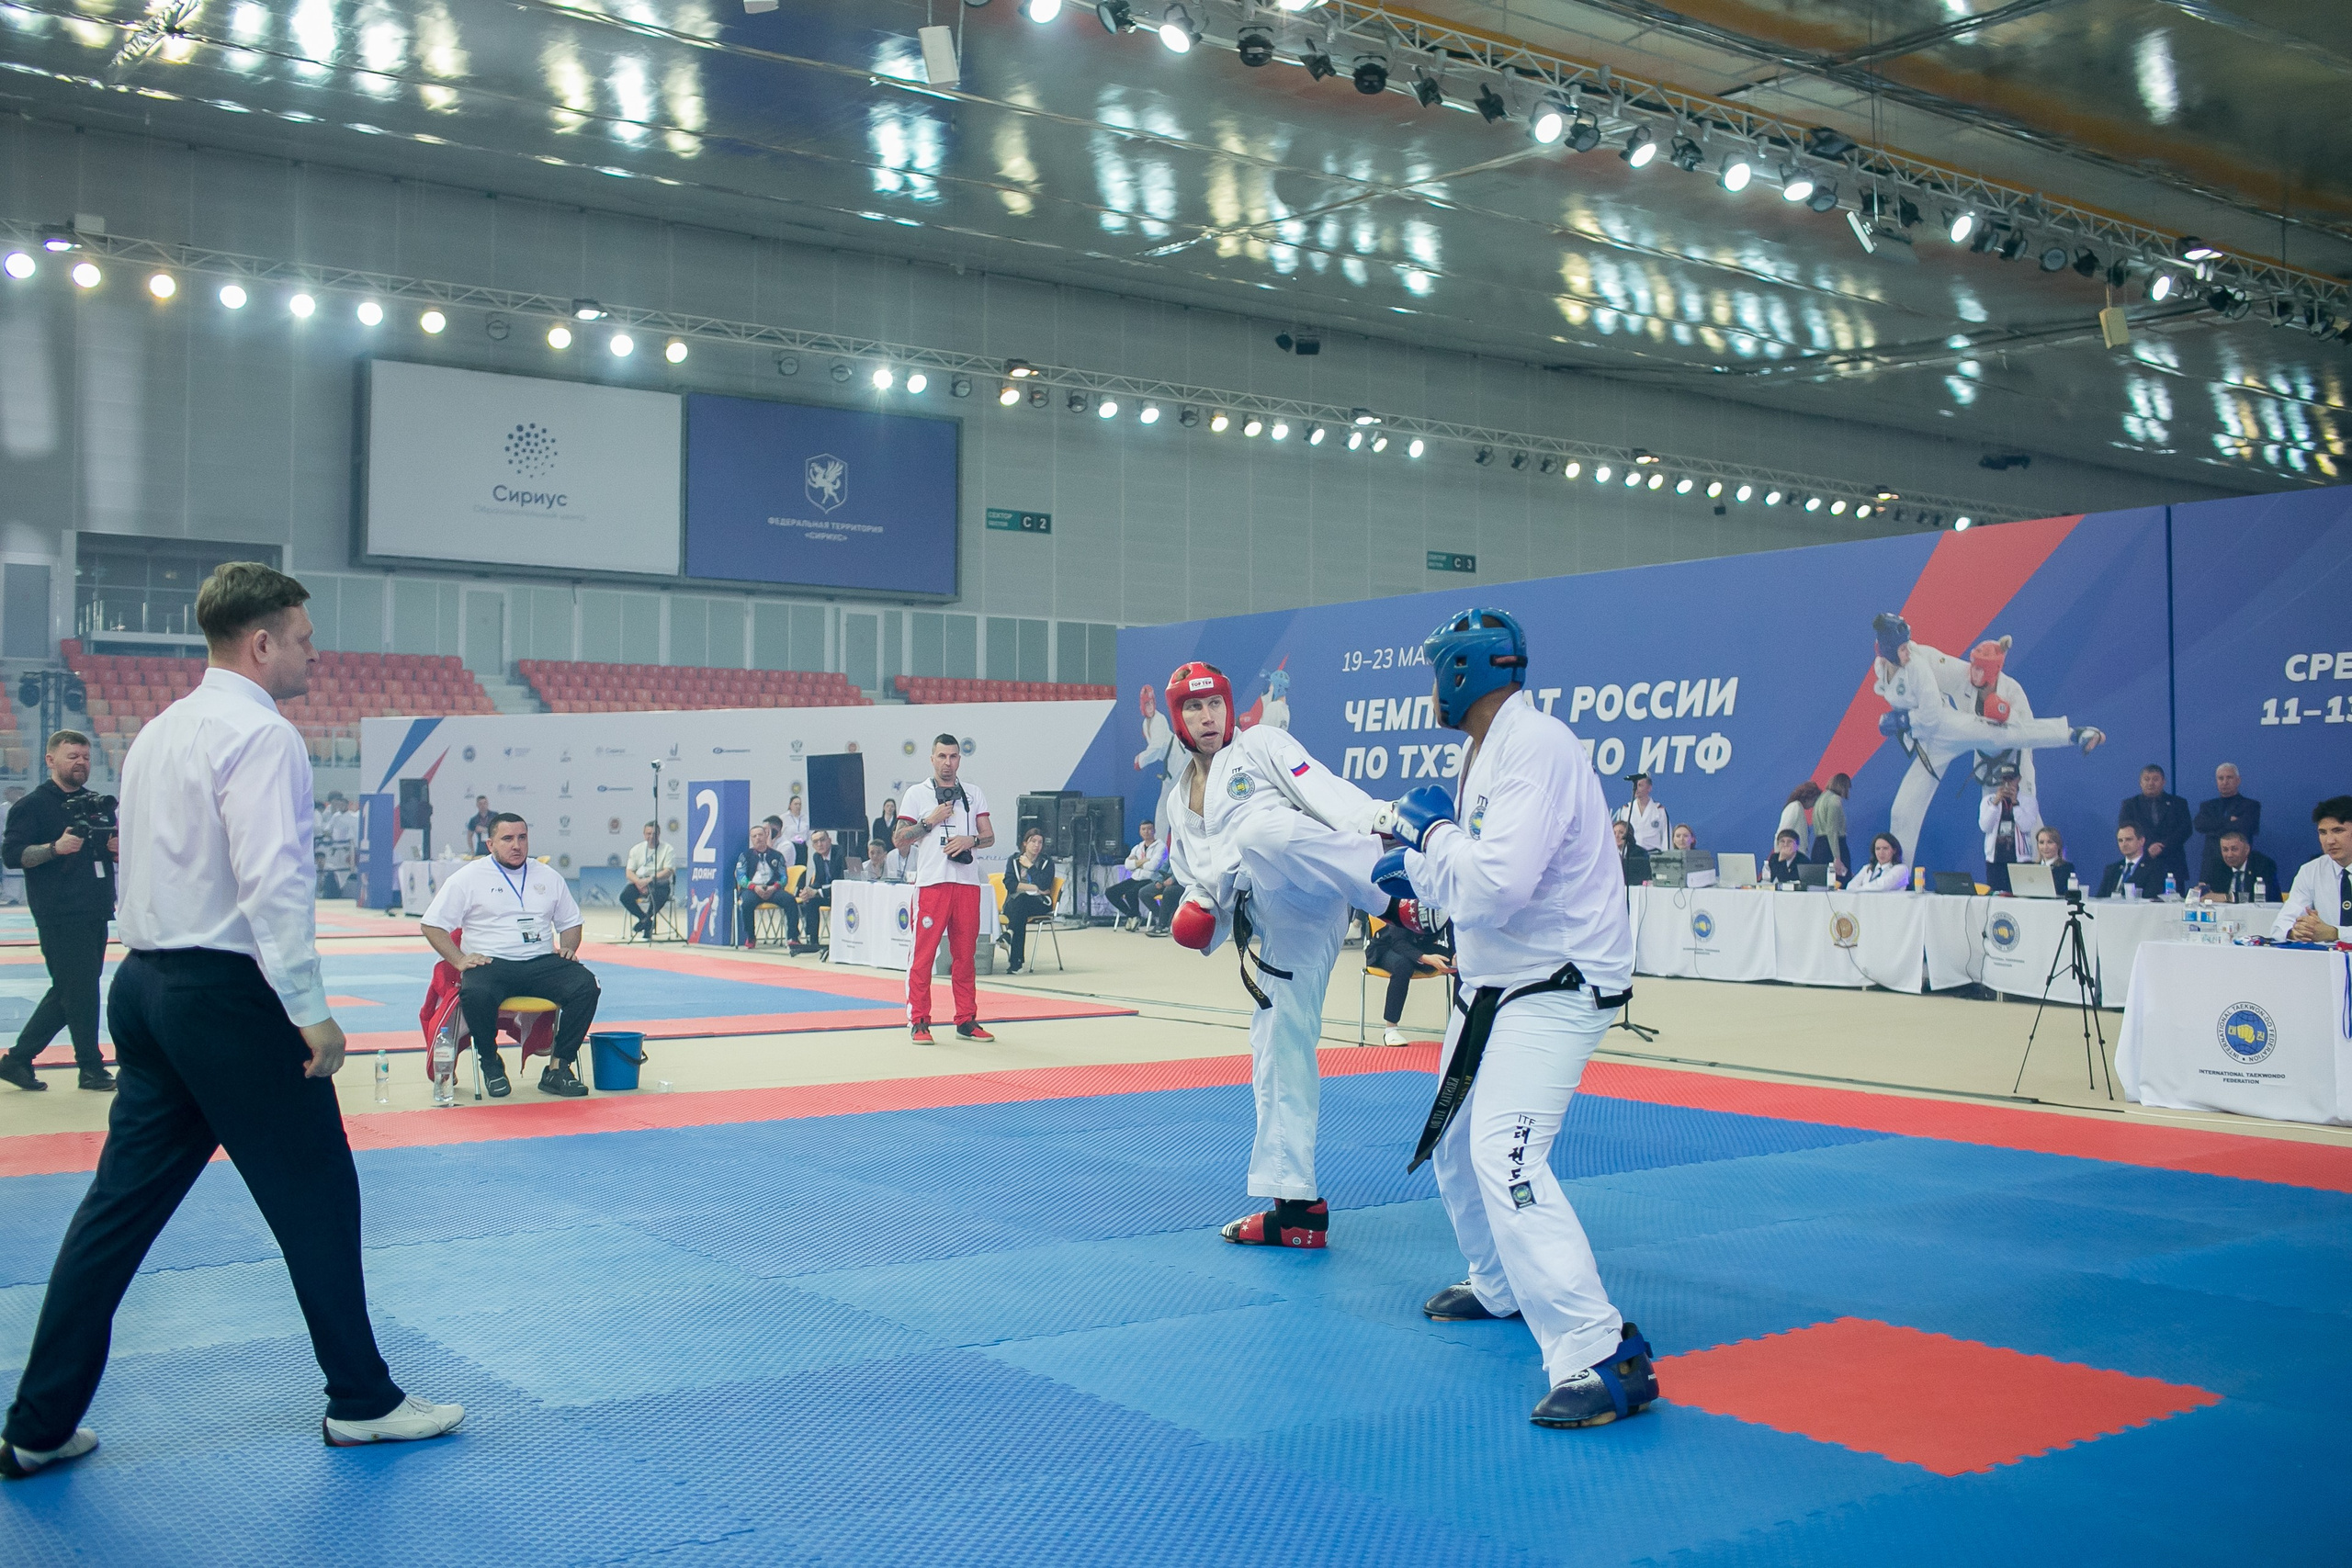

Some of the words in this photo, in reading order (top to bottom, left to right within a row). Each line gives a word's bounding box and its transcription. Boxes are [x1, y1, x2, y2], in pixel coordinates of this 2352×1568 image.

[492, 484, 568, 510] Сириус
[1039, 517, 1047, 530] 2
[1397, 646, 1433, 667] МА
[1569, 677, 1738, 723] РОССИИ
[1341, 745, 1388, 780] ПО
[1637, 732, 1733, 775] ИТФ
[692, 788, 718, 863] 2
[691, 867, 717, 882] ДОЯНГ
[2218, 1010, 2240, 1060] INTERNATIONAL
[2248, 1029, 2276, 1062] FEDERATION
[2199, 1068, 2245, 1077] INTERNATIONAL
[1519, 1113, 1536, 1126] ITF
